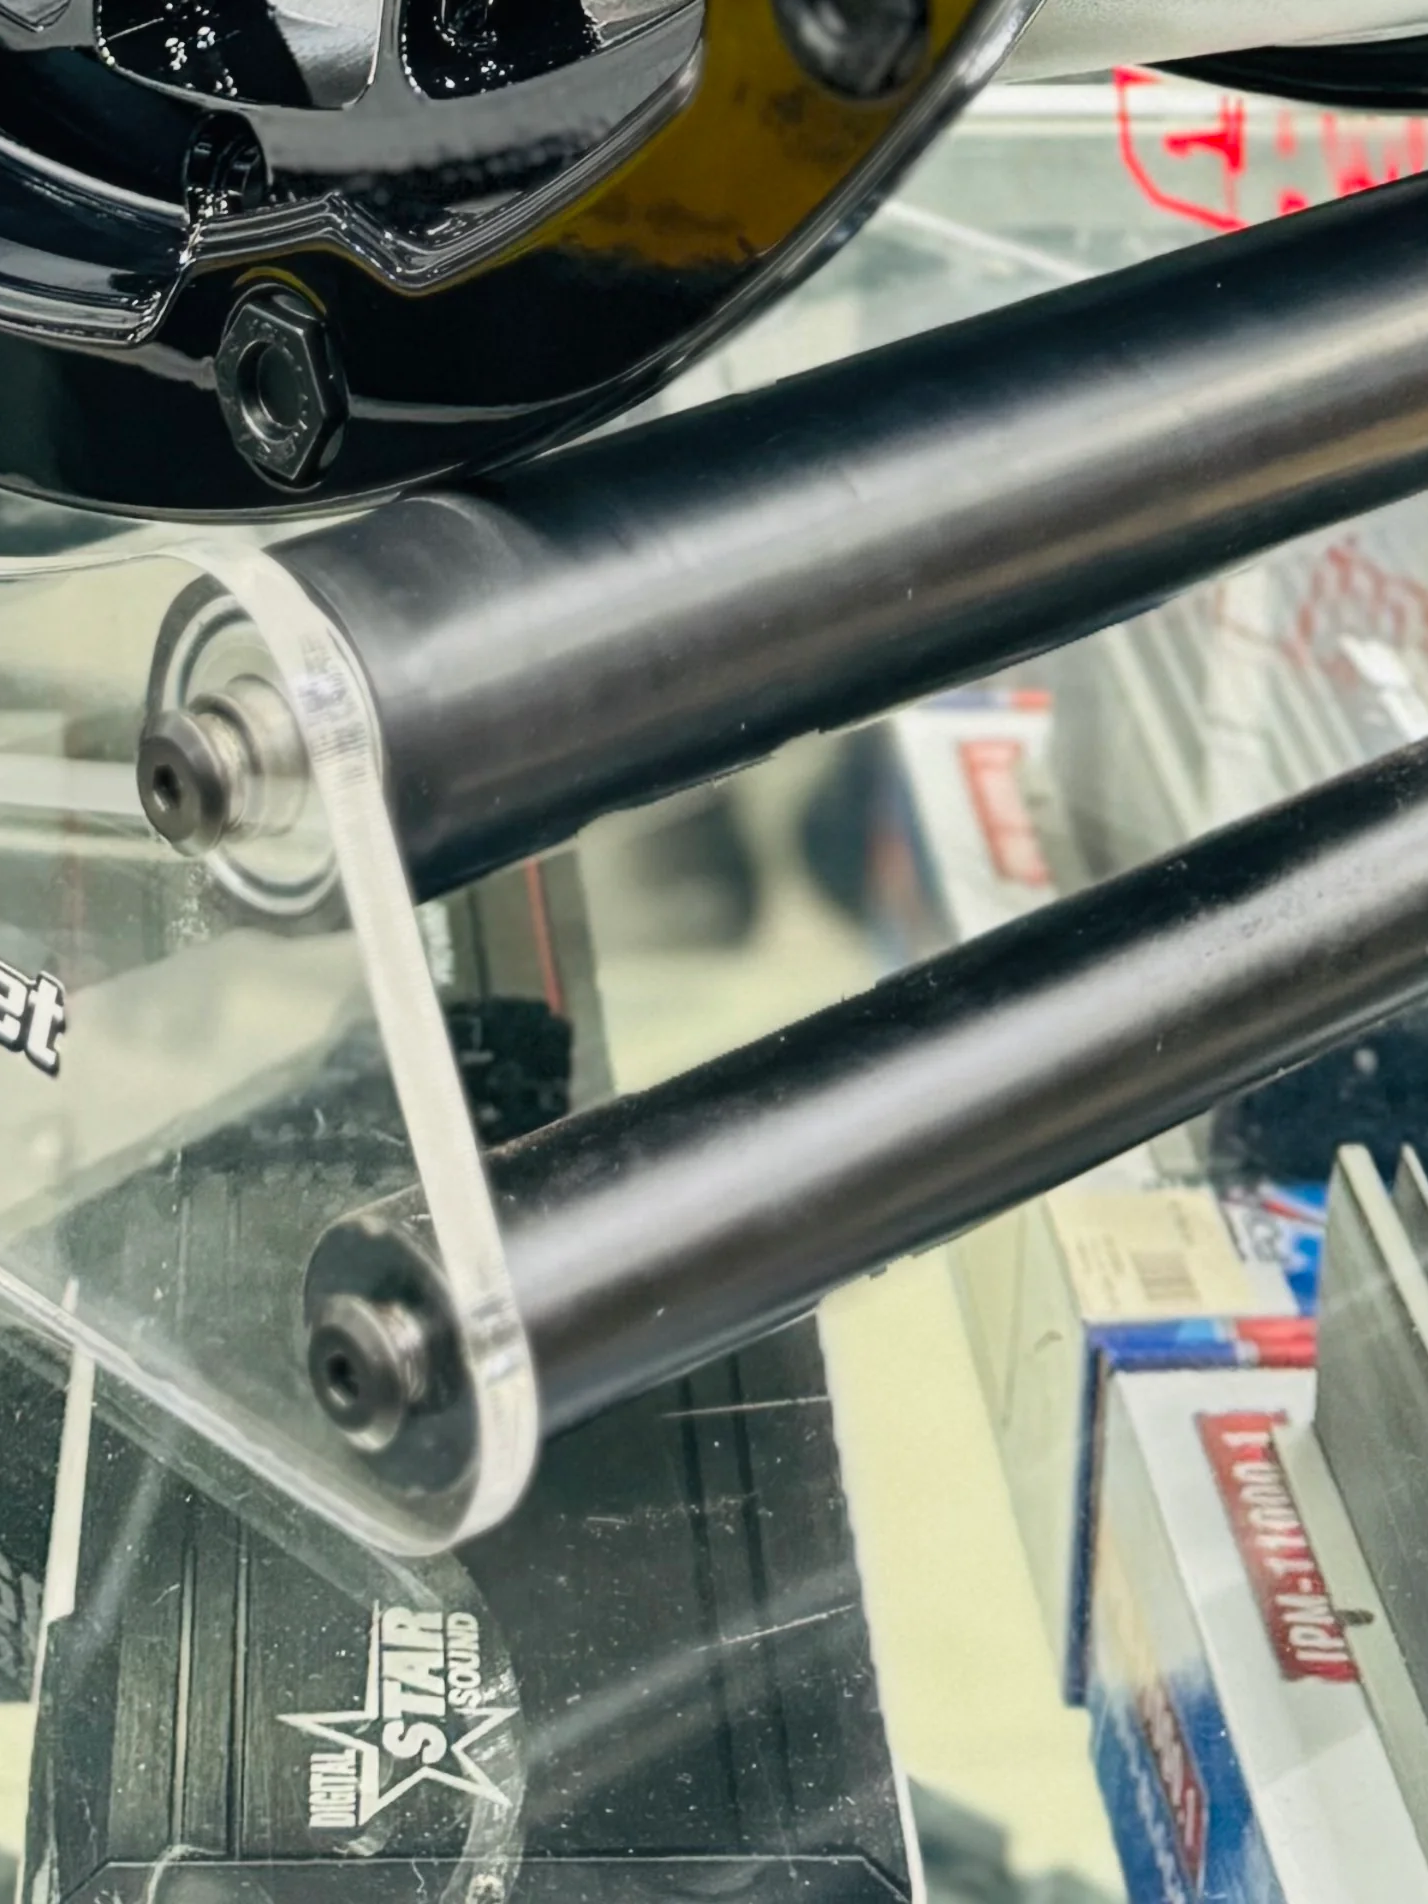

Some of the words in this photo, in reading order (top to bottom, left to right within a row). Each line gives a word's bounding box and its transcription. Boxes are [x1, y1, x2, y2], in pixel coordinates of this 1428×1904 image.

[383, 1608, 448, 1763] STAR
[448, 1613, 481, 1707] SOUND
[310, 1750, 359, 1828] DIGITAL
